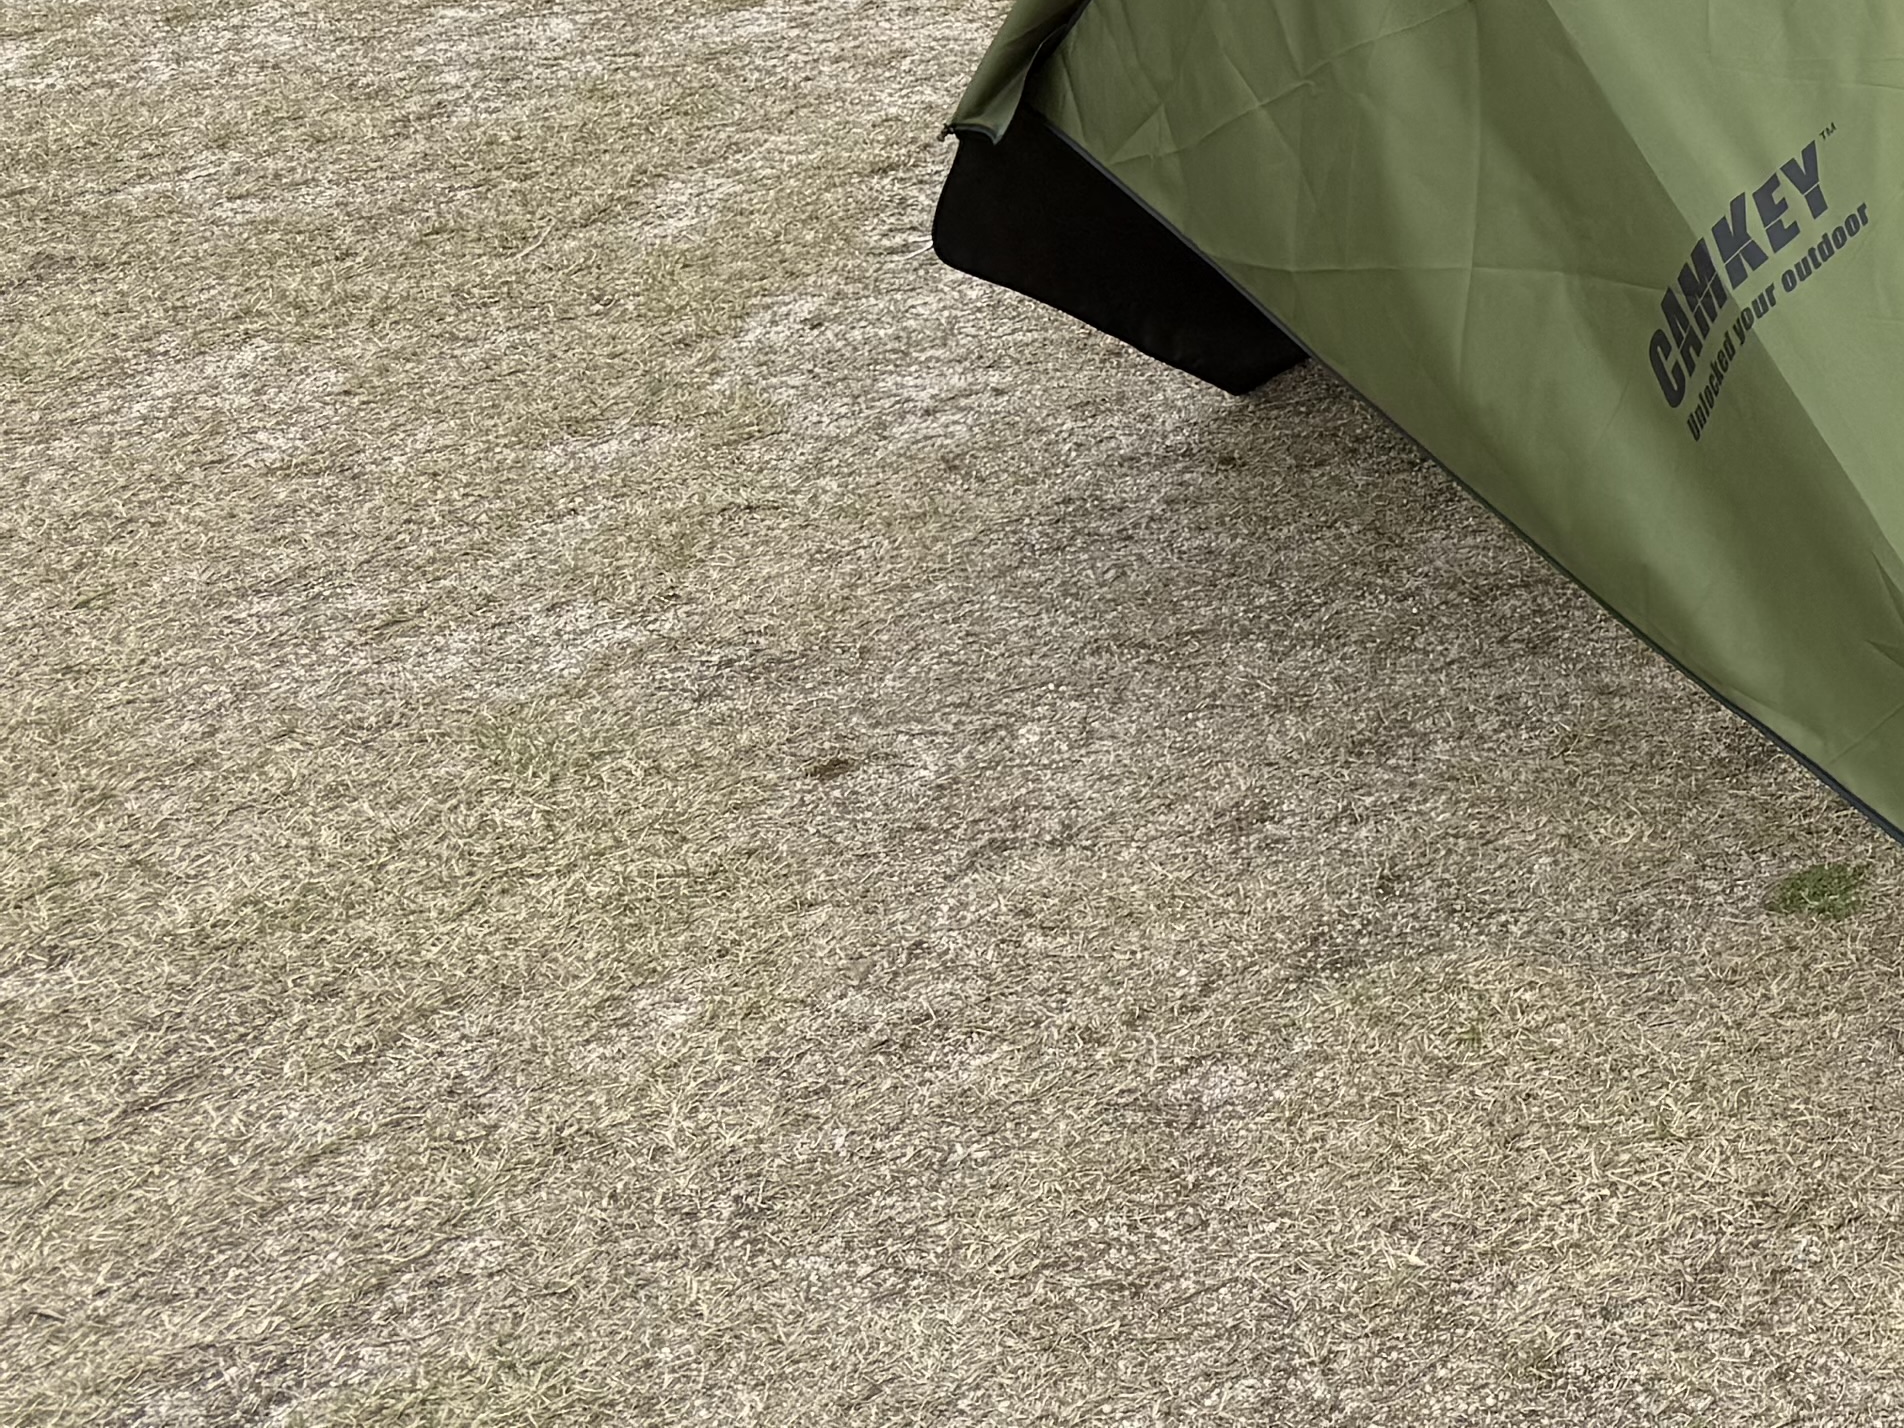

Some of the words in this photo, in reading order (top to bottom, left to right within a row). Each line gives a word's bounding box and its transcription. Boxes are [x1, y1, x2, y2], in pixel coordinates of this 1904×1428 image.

[1649, 140, 1828, 408] CAMKEY
[1686, 329, 1737, 442] Unlocked
[1732, 282, 1776, 347] your
[1781, 202, 1870, 294] outdoor
